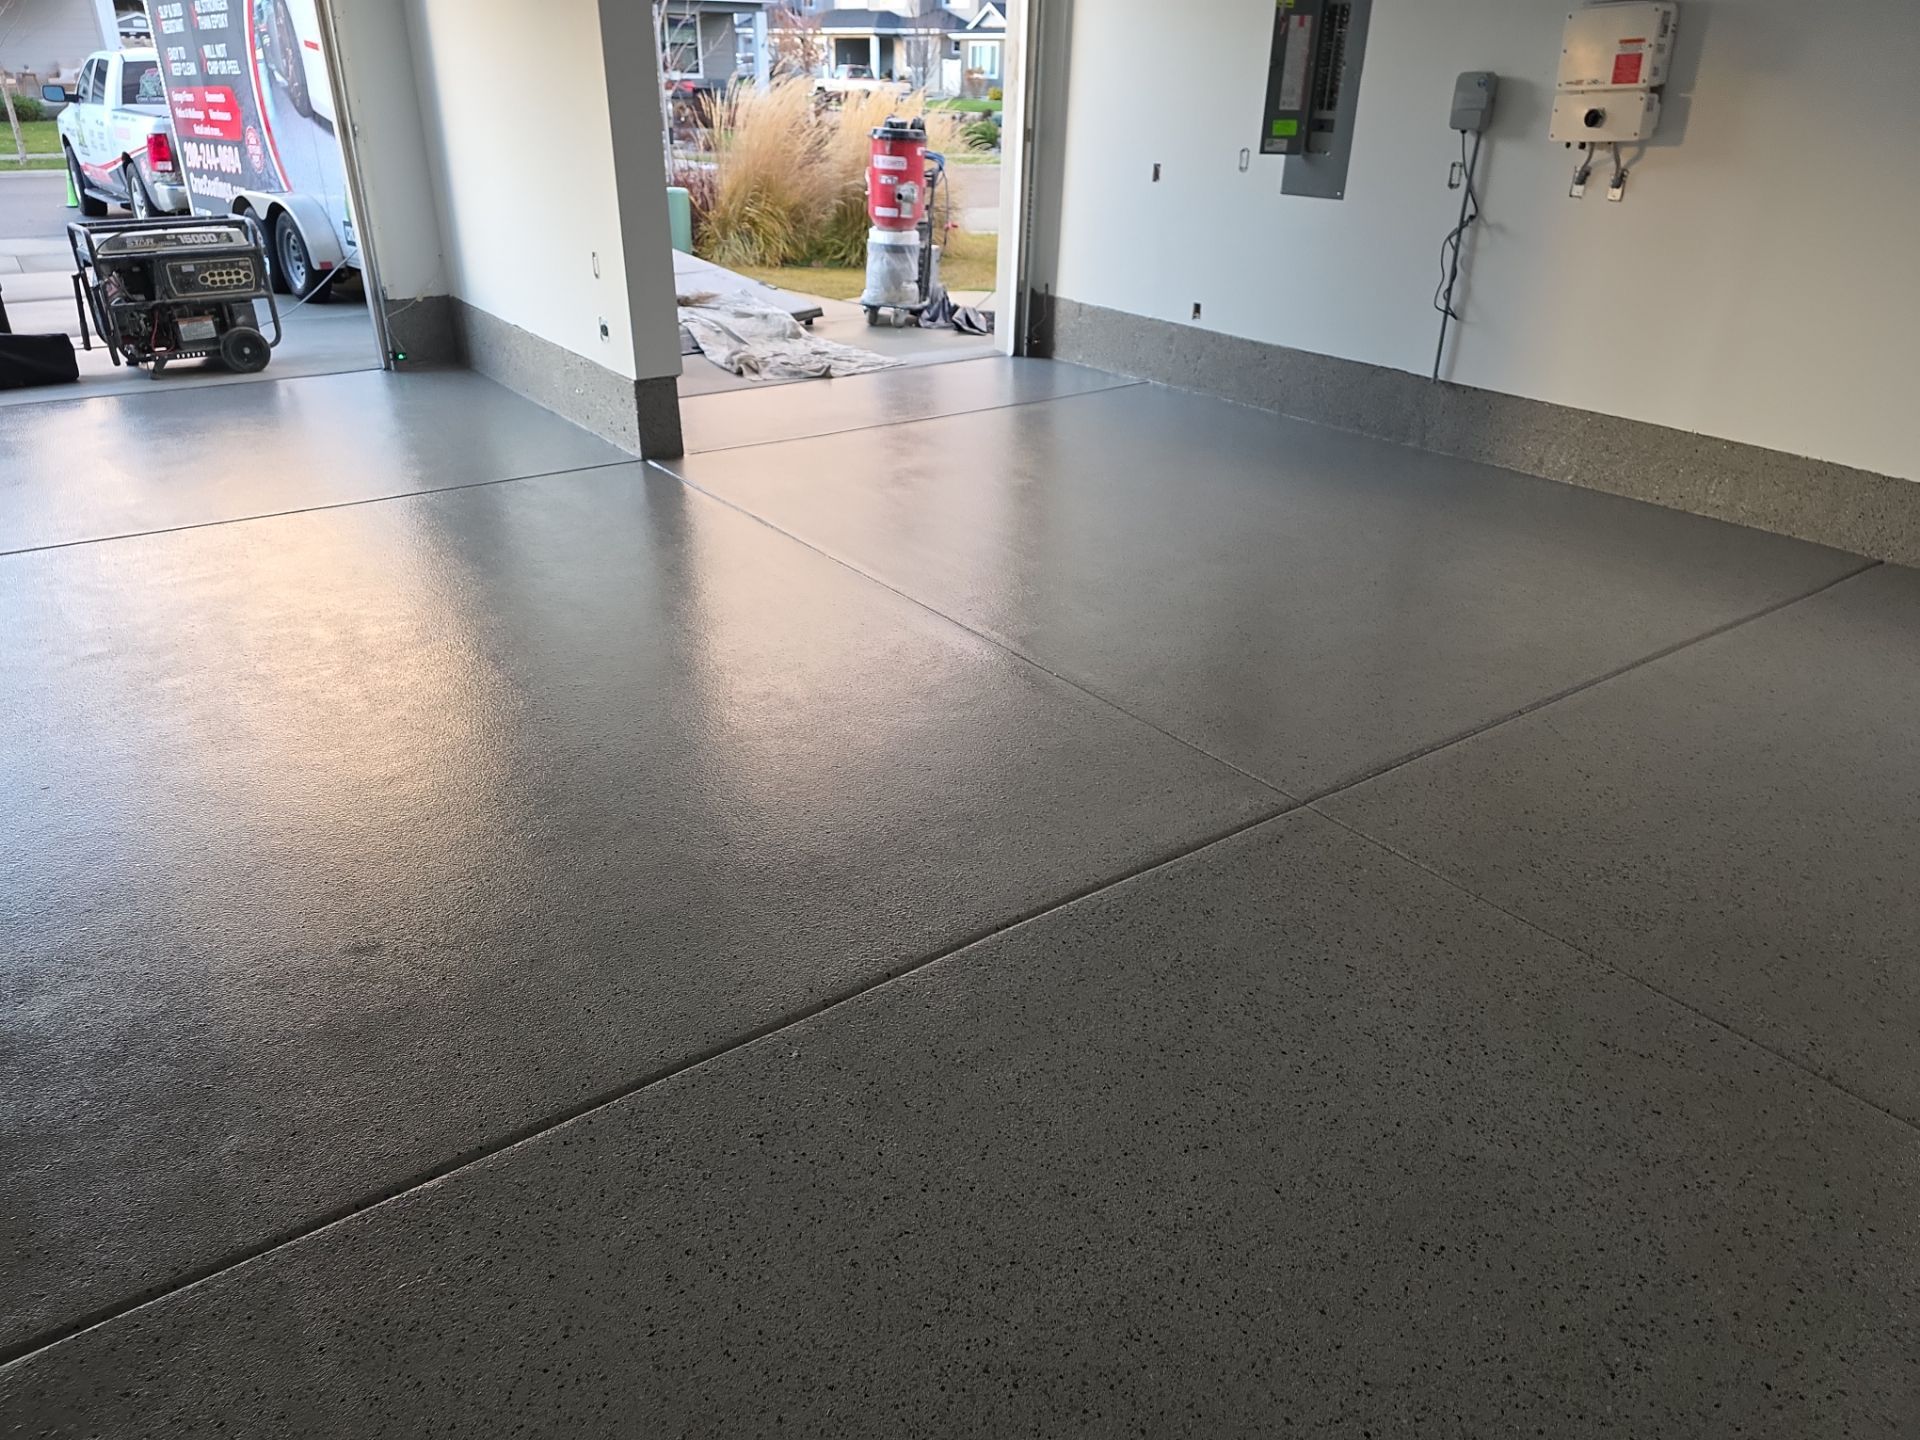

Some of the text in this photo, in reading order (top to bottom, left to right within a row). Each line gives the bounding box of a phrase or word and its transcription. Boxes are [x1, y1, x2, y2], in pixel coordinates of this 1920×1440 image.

[206, 59, 241, 75] CHIP OR PEEL
[177, 232, 218, 244] 15000
